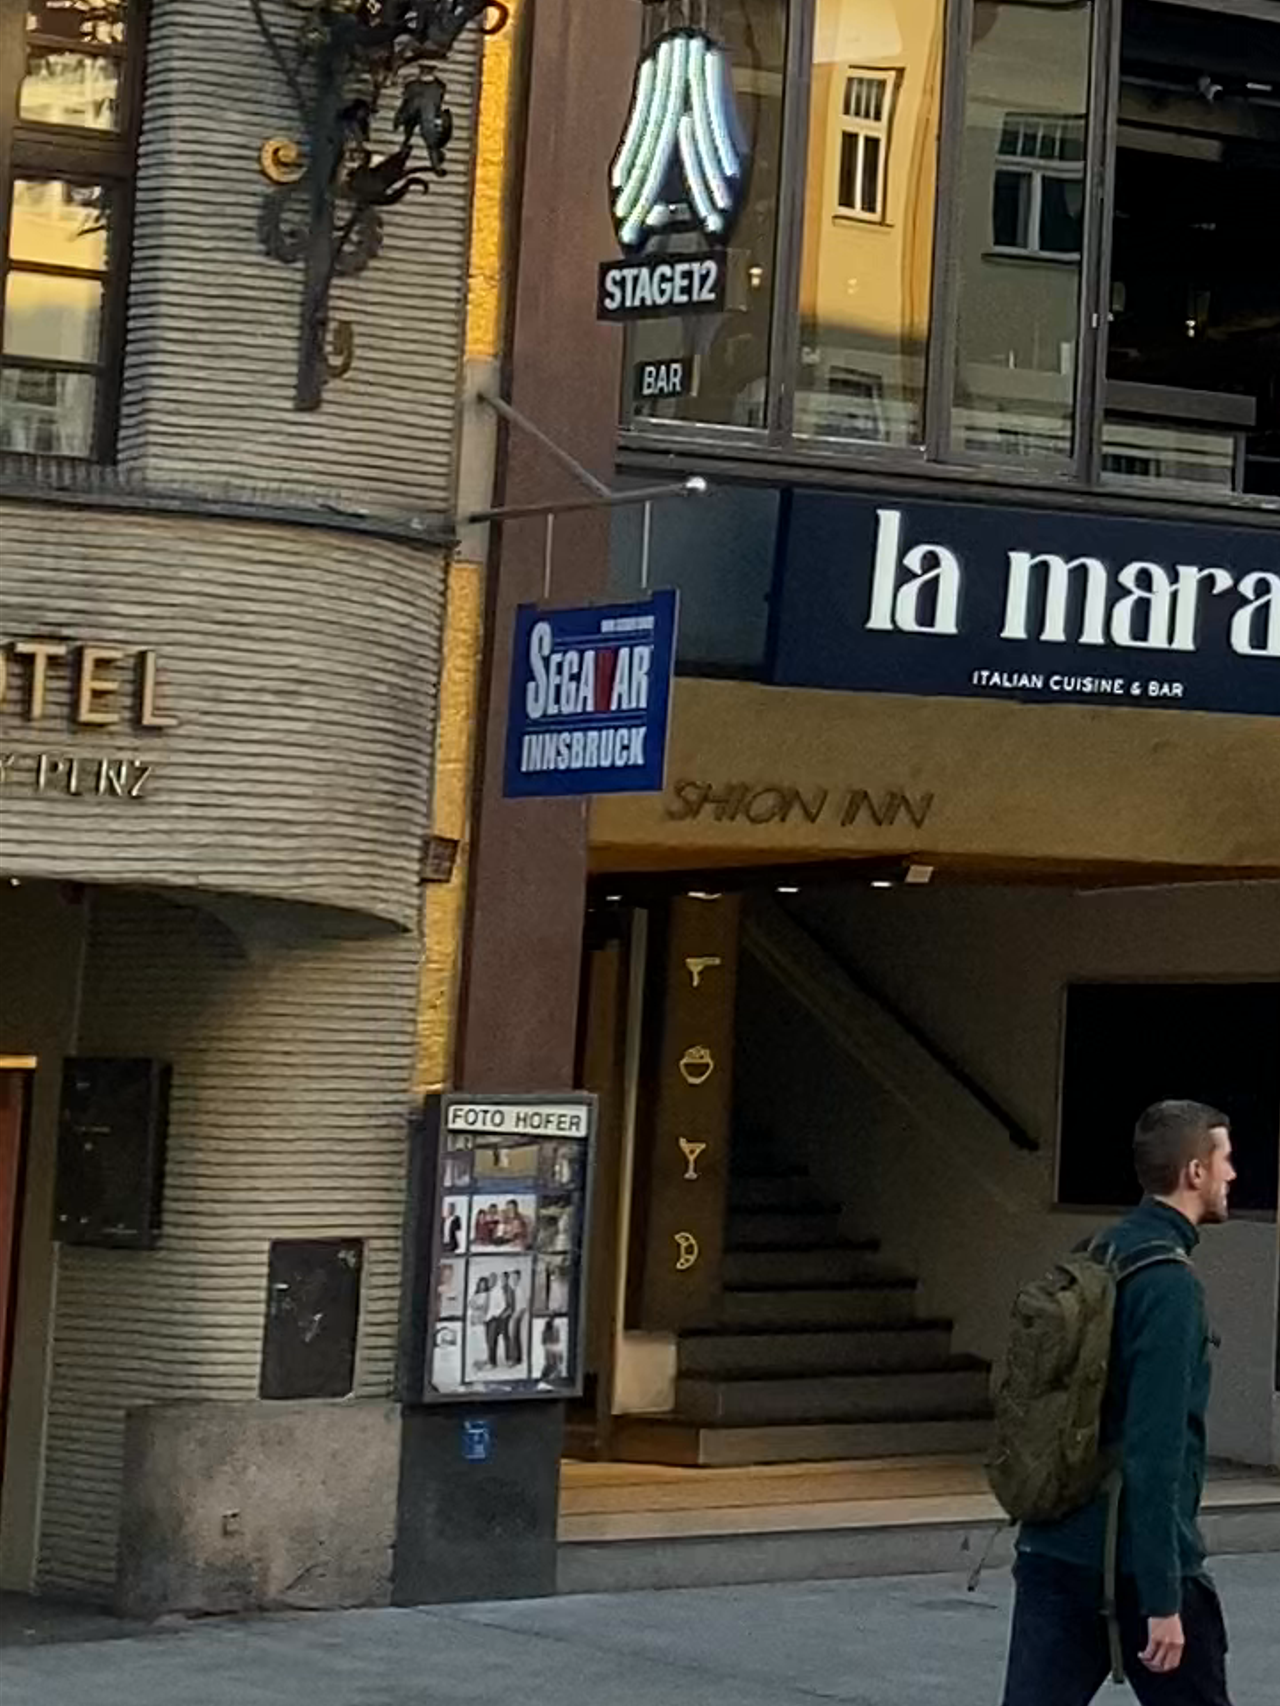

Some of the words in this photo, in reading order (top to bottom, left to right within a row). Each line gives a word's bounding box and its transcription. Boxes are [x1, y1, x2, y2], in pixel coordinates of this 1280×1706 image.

[603, 259, 719, 311] STAGE12
[642, 362, 683, 397] BAR
[864, 508, 961, 636] la
[0, 641, 180, 727] TEL
[972, 669, 1045, 692] ITALIAN
[1049, 674, 1125, 696] CUISINE
[1130, 681, 1142, 696] &
[1147, 680, 1185, 699] BAR
[520, 726, 648, 773] INNSBRUCK
[841, 788, 936, 830] INN
[451, 1107, 505, 1128] FOTO
[514, 1110, 583, 1133] HOFER
